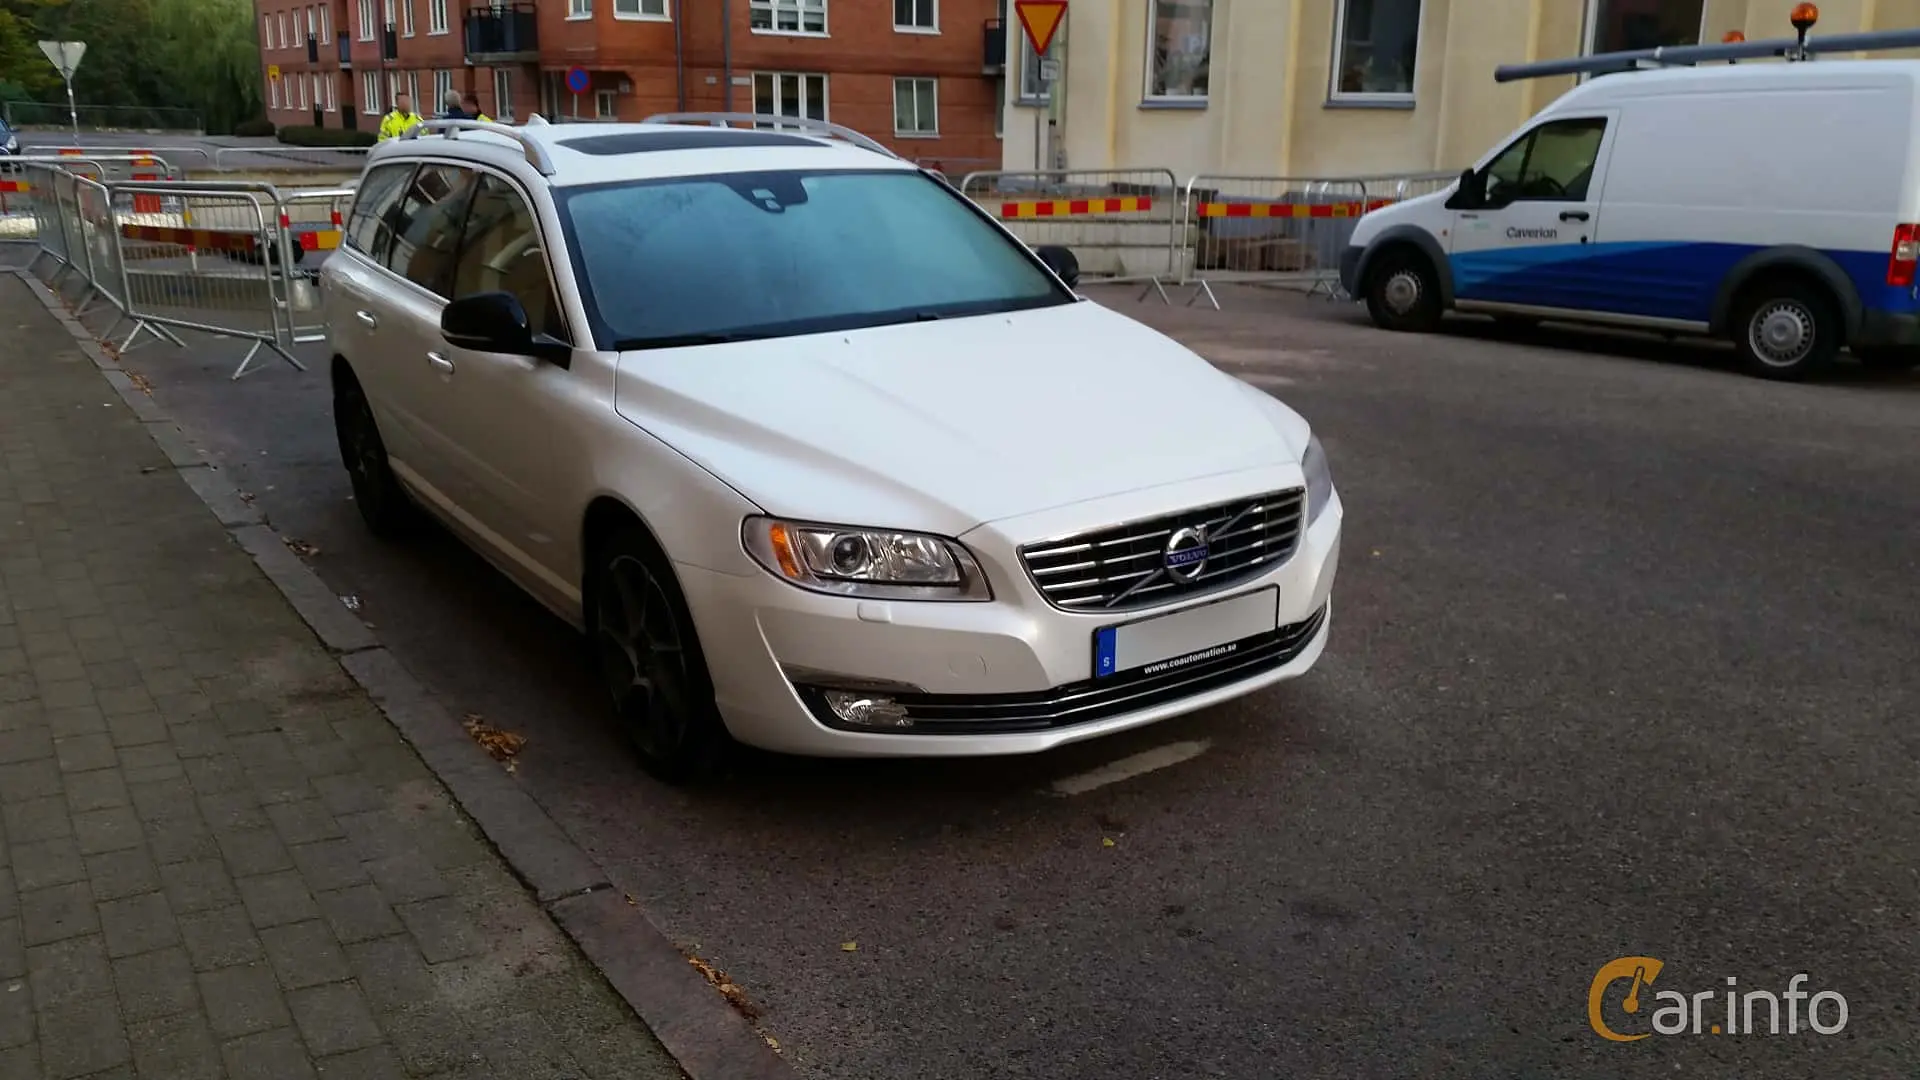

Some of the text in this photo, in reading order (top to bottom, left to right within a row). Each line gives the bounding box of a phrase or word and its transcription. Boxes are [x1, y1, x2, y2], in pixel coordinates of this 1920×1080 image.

[1506, 226, 1558, 239] Caverion
[1168, 549, 1207, 564] VOLVO
[1103, 656, 1110, 668] S
[1144, 643, 1237, 675] www.coautomation.se
